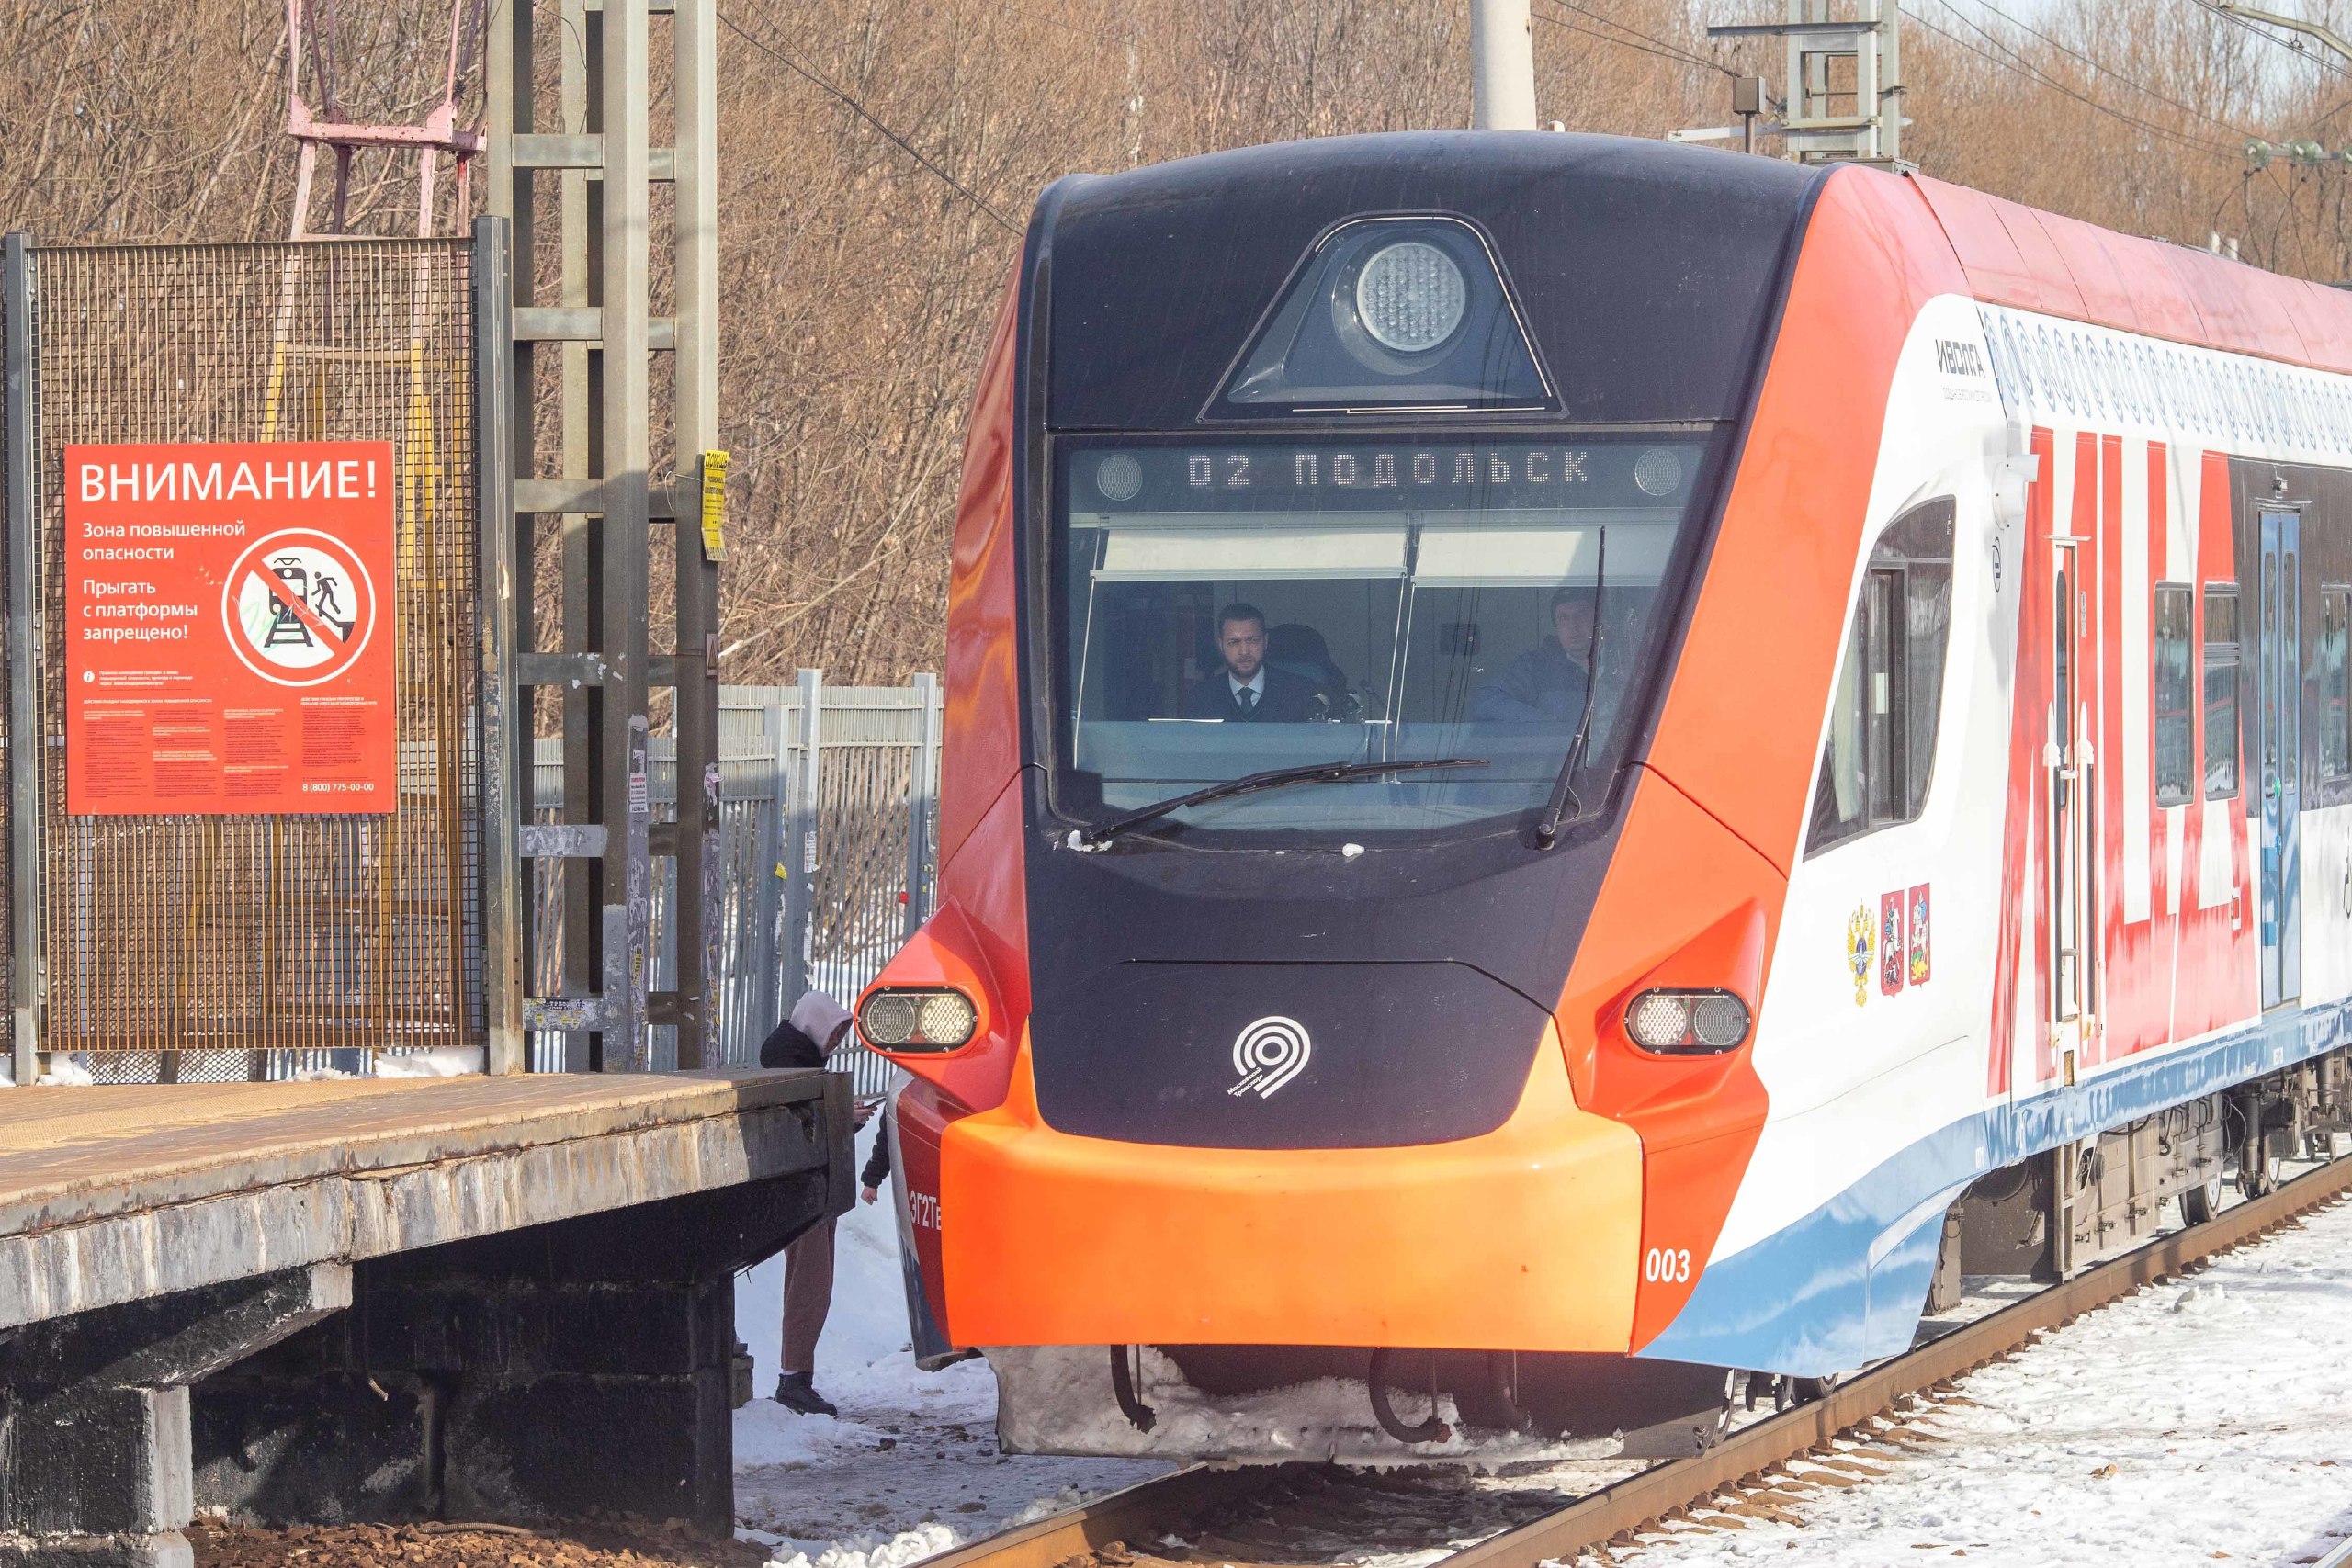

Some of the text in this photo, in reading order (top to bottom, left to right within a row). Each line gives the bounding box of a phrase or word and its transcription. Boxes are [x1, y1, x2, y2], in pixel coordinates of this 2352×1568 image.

[1935, 339, 1986, 378] ИВОЛГА
[1188, 451, 1589, 488] D2 ПОДОЛЬСК
[80, 460, 377, 502] ВНИМАНИЕ!
[83, 520, 245, 538] Зона повышенной
[83, 547, 175, 560] опасности
[83, 580, 156, 597] Прыгать
[83, 604, 198, 621] с платформы
[83, 625, 188, 643] запрещено!
[302, 783, 375, 793] 8 (800) 775-00-00
[1227, 1066, 1263, 1096] Московский
[1645, 1247, 1690, 1283] 003
